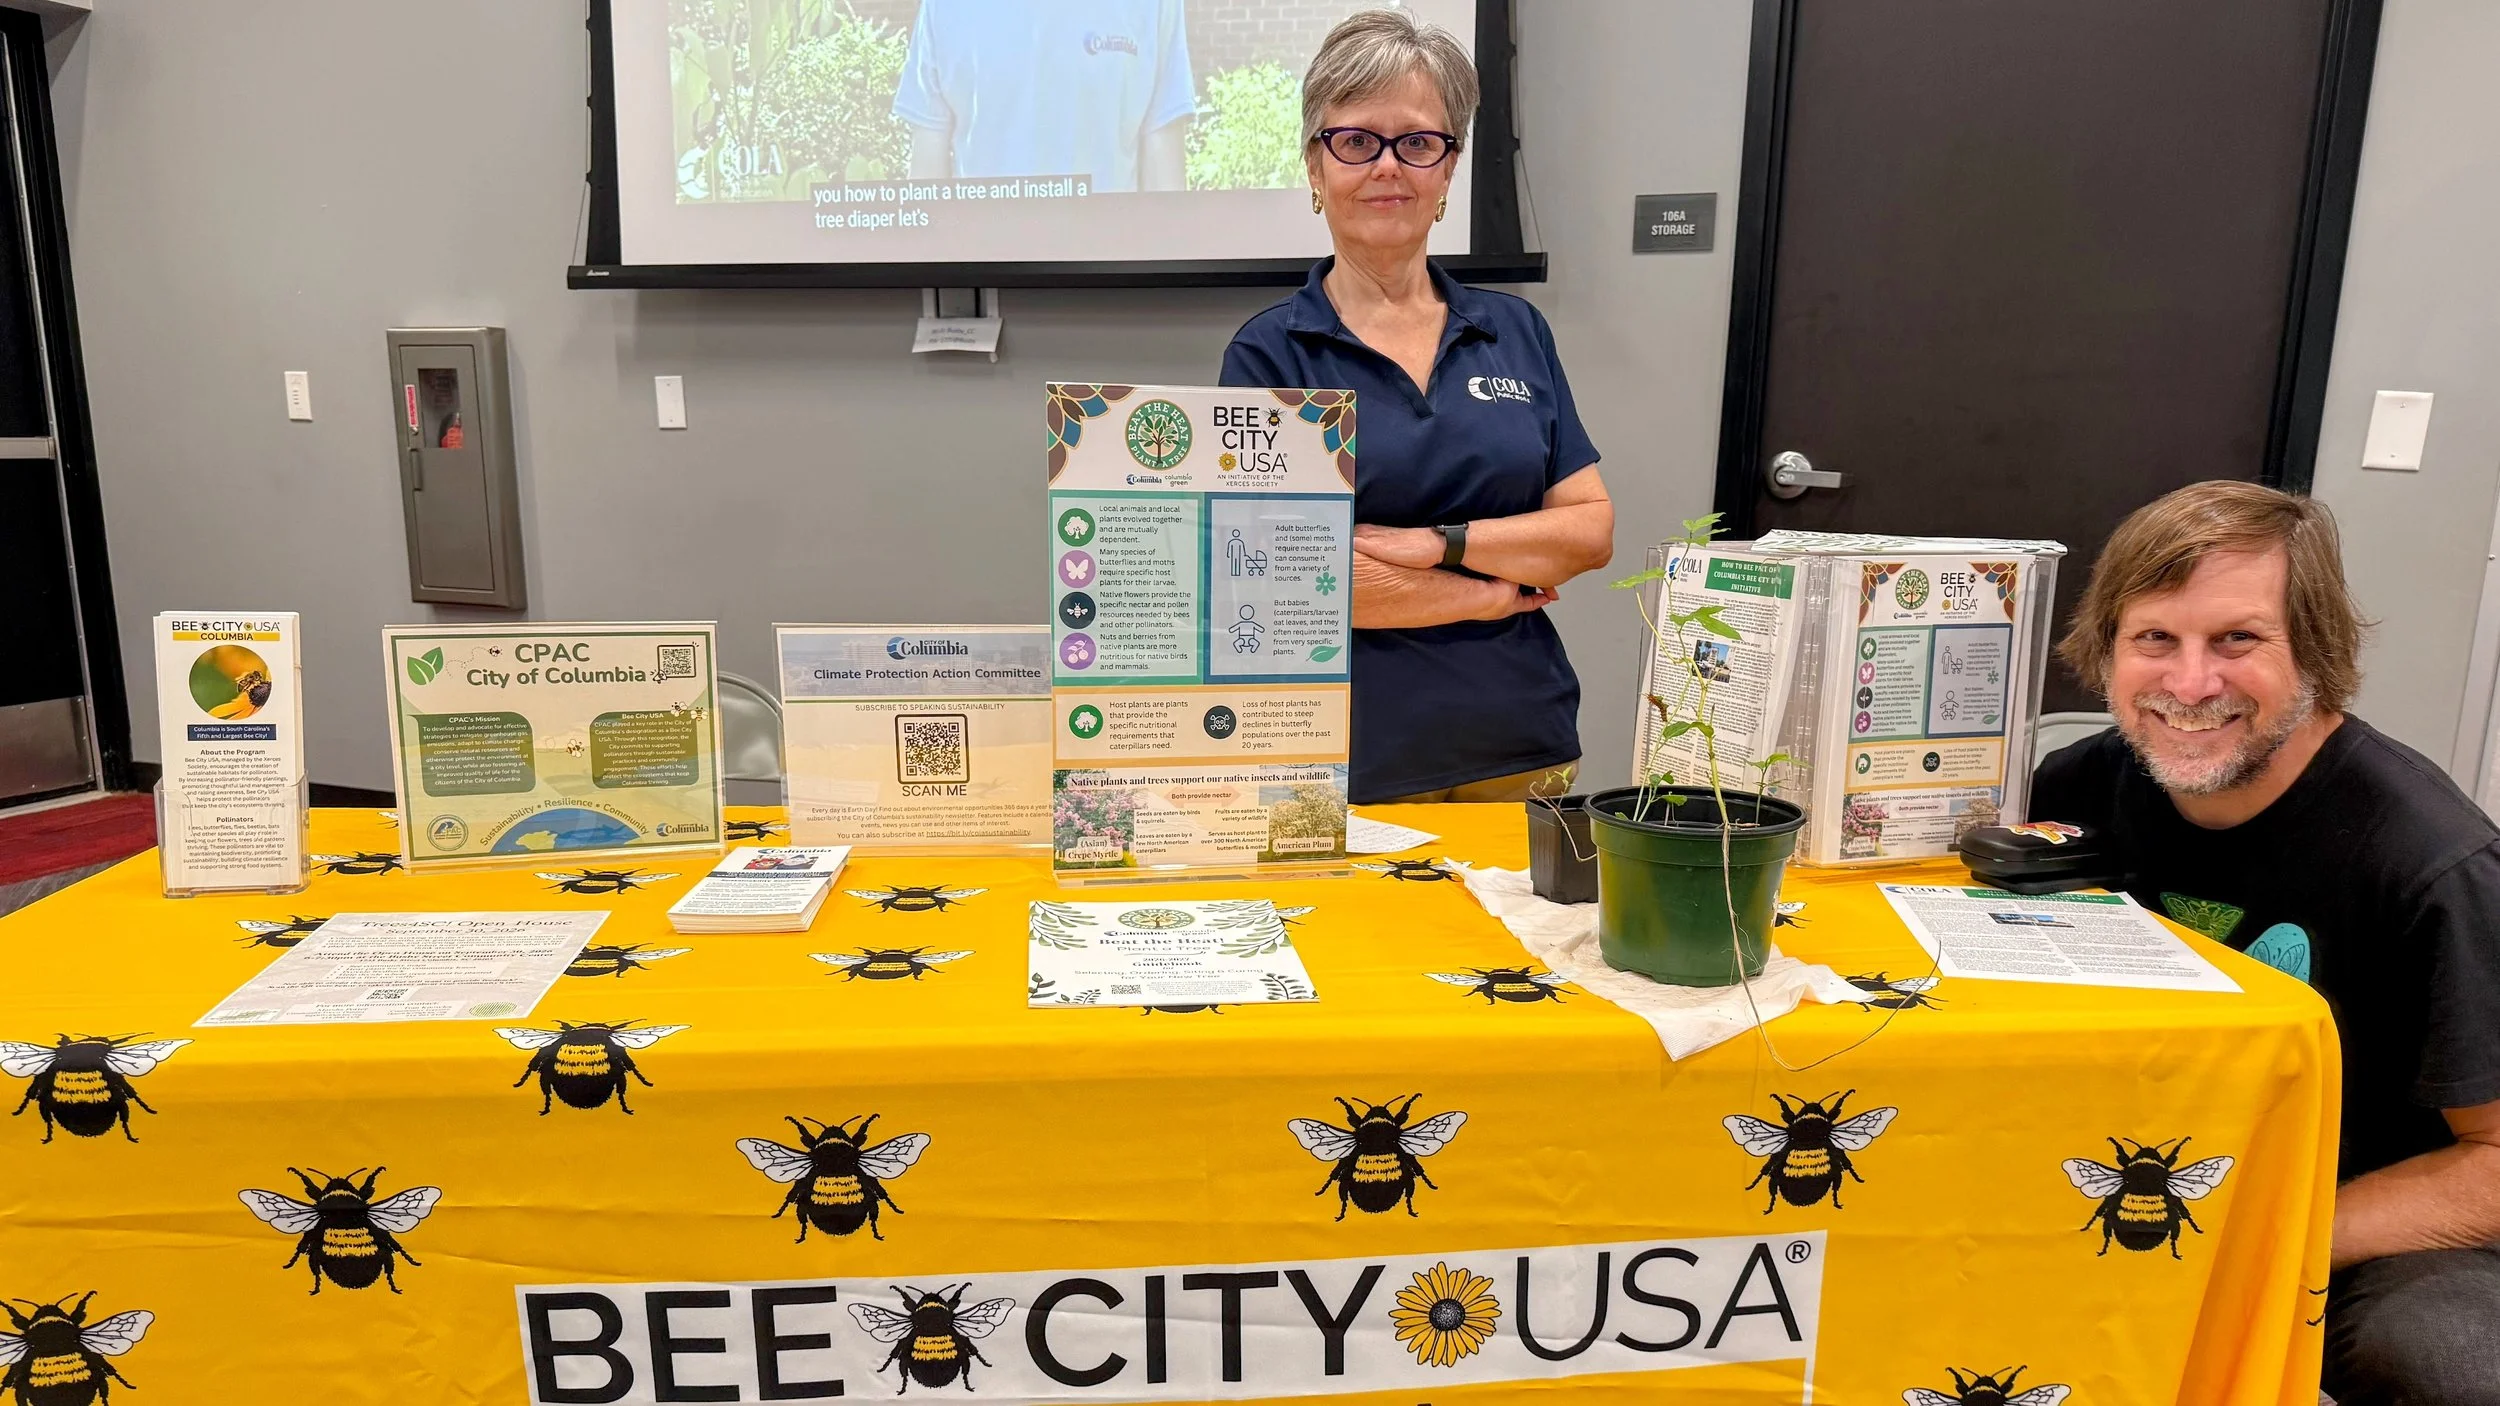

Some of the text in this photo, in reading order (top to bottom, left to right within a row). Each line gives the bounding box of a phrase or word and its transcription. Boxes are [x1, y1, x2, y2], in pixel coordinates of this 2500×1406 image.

[814, 178, 1087, 207] you how to plant a tree and install a
[815, 208, 929, 231] tree diaper let's
[1662, 210, 1686, 222] 106A
[1651, 224, 1696, 236] STORAGE
[1492, 377, 1531, 396] COLA
[1128, 402, 1188, 441] BEAT THE HEAT
[1214, 406, 1259, 427] BEE
[1222, 429, 1278, 450] CITY
[1131, 446, 1157, 467] PLANT
[1169, 446, 1187, 464] TREE
[1132, 476, 1162, 484] Columbia
[1165, 473, 1192, 482] columbia
[1170, 479, 1188, 487] green
[1153, 516, 1182, 524] together
[1127, 526, 1158, 534] mutually
[1099, 536, 1140, 544] dependent.
[1682, 557, 1702, 574] COLA
[1941, 572, 1965, 585] BEE
[1731, 584, 1761, 593] INITIATIVE
[1944, 583, 1974, 598] CITY
[172, 621, 198, 631] BEE
[212, 621, 245, 631] CITY
[201, 632, 253, 640] COLUMBIA
[515, 643, 590, 663] CPAC
[901, 641, 968, 656] Columbia
[467, 665, 646, 689] City of Columbia
[814, 668, 1040, 679] Climate Protection Action Committee
[1128, 701, 1151, 709] plants
[1166, 701, 1188, 709] plants
[1126, 711, 1154, 720] provide
[1109, 722, 1137, 730] specific
[1110, 742, 1150, 750] caterpillars
[1071, 776, 1098, 786] Native
[1101, 777, 1127, 787] plants
[1130, 776, 1145, 785] and
[1171, 776, 1204, 785] support
[1224, 774, 1249, 782] native
[1251, 773, 1280, 782] insects
[1282, 772, 1297, 781] and
[1299, 772, 1330, 780] wildlife
[902, 785, 967, 797] SCAN ME
[480, 805, 535, 846] Sustainability
[544, 798, 593, 808] Resilience
[603, 804, 648, 835] Community
[665, 822, 709, 836] Columbia
[1081, 840, 1107, 848] (Asian)
[1275, 841, 1310, 849] American
[1068, 850, 1118, 860] Crepe Myrtle
[1025, 1265, 1383, 1389] CITY
[526, 1286, 844, 1405] BEE
